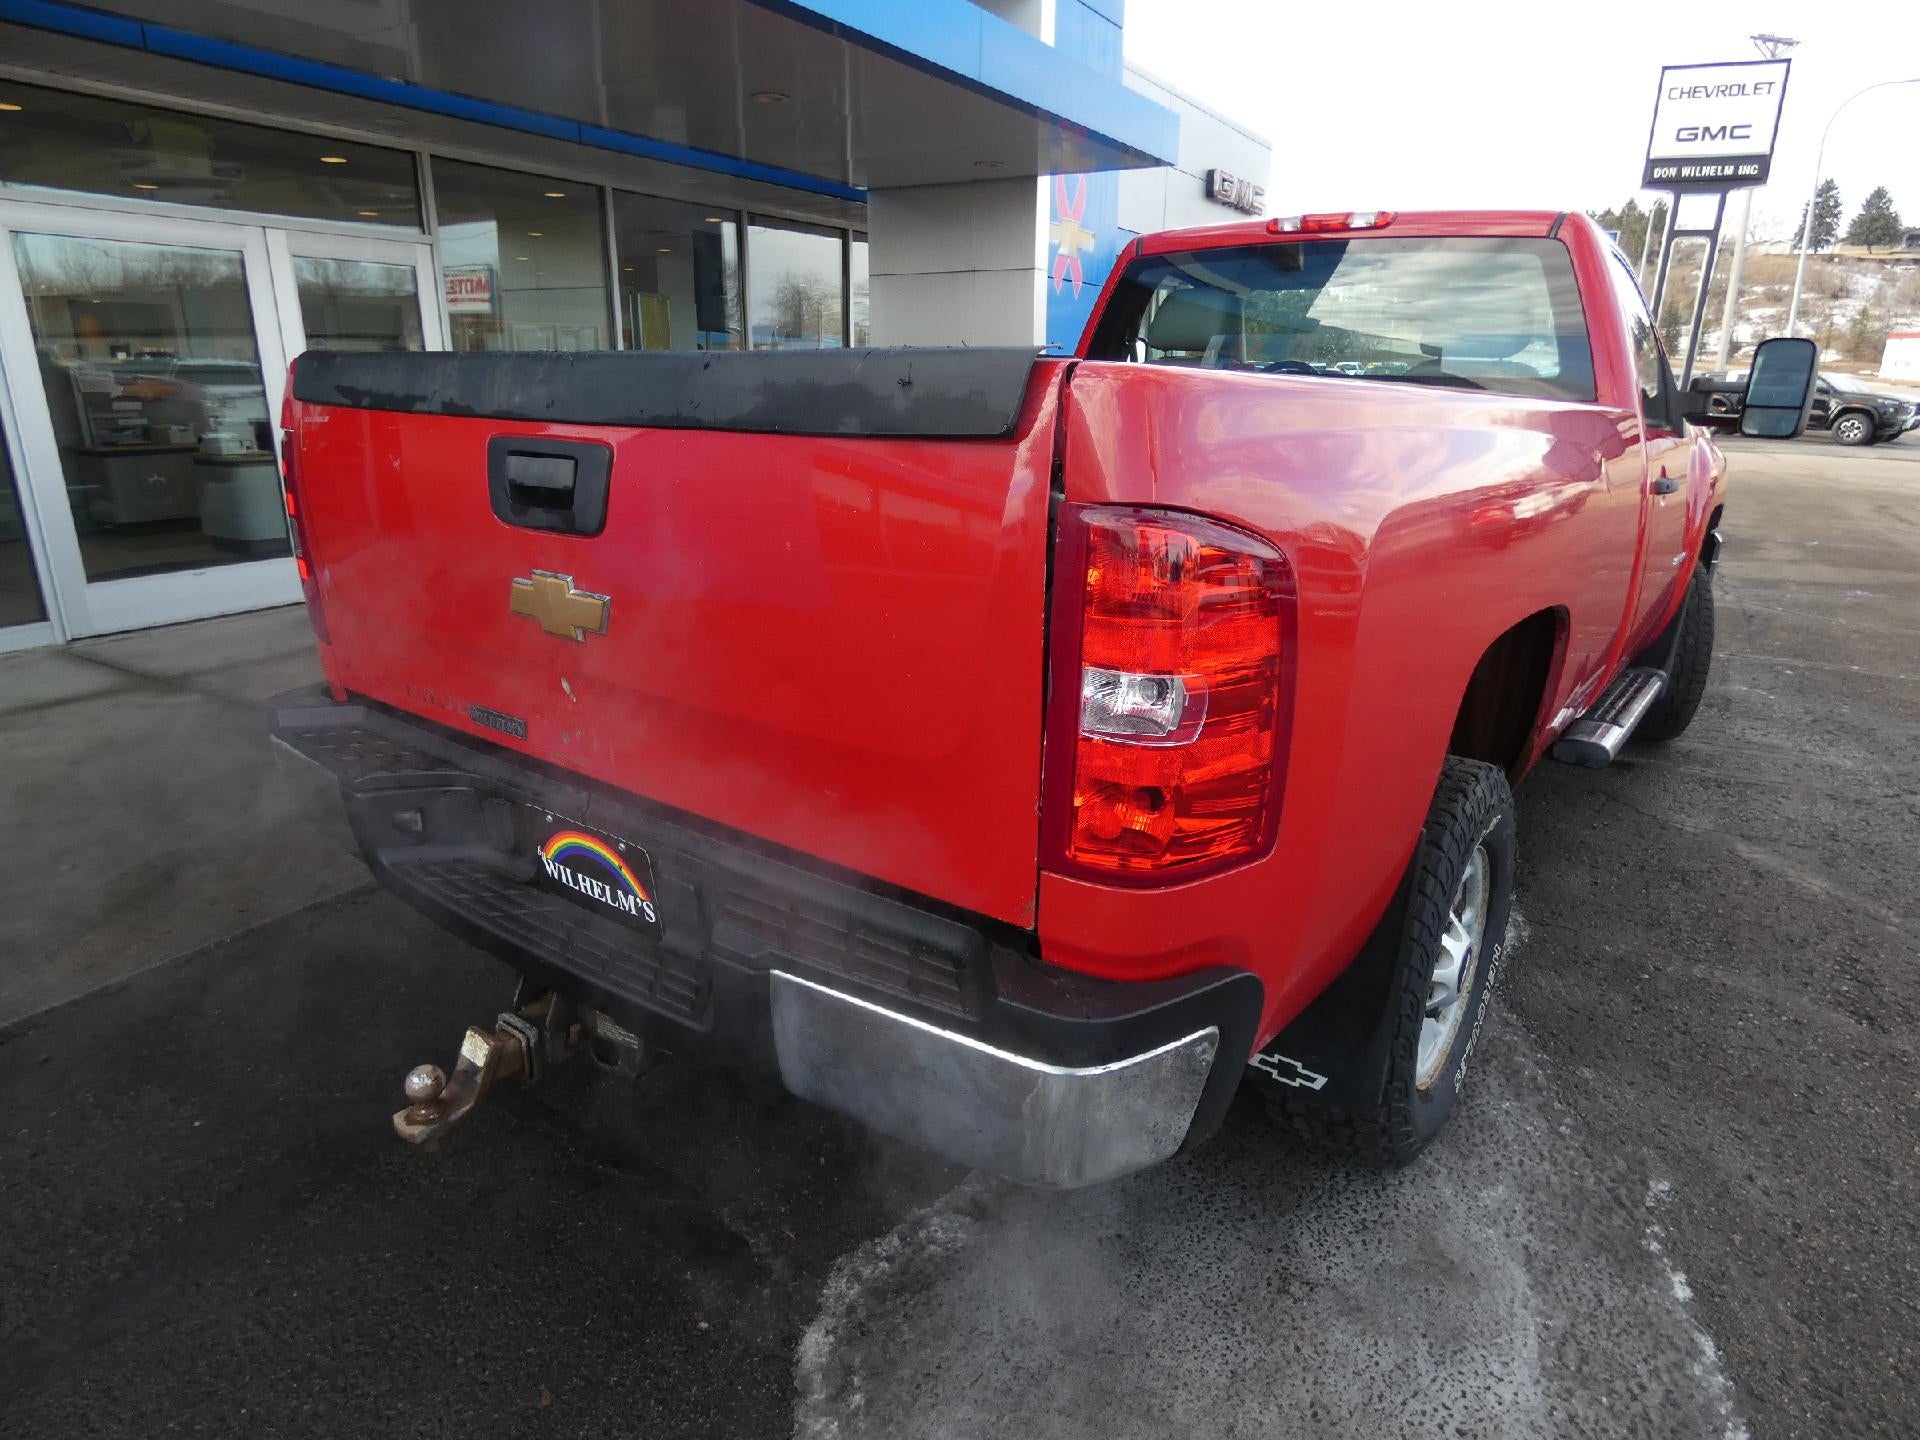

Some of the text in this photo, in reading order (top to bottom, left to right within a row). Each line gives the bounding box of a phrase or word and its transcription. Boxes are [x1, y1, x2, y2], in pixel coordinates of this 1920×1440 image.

[1668, 81, 1776, 100] CHEVROLET
[1675, 124, 1752, 142] GMC
[1653, 164, 1759, 178] DON WILHELM INC
[1208, 169, 1264, 214] GMC
[543, 857, 656, 923] WILHELM'S
